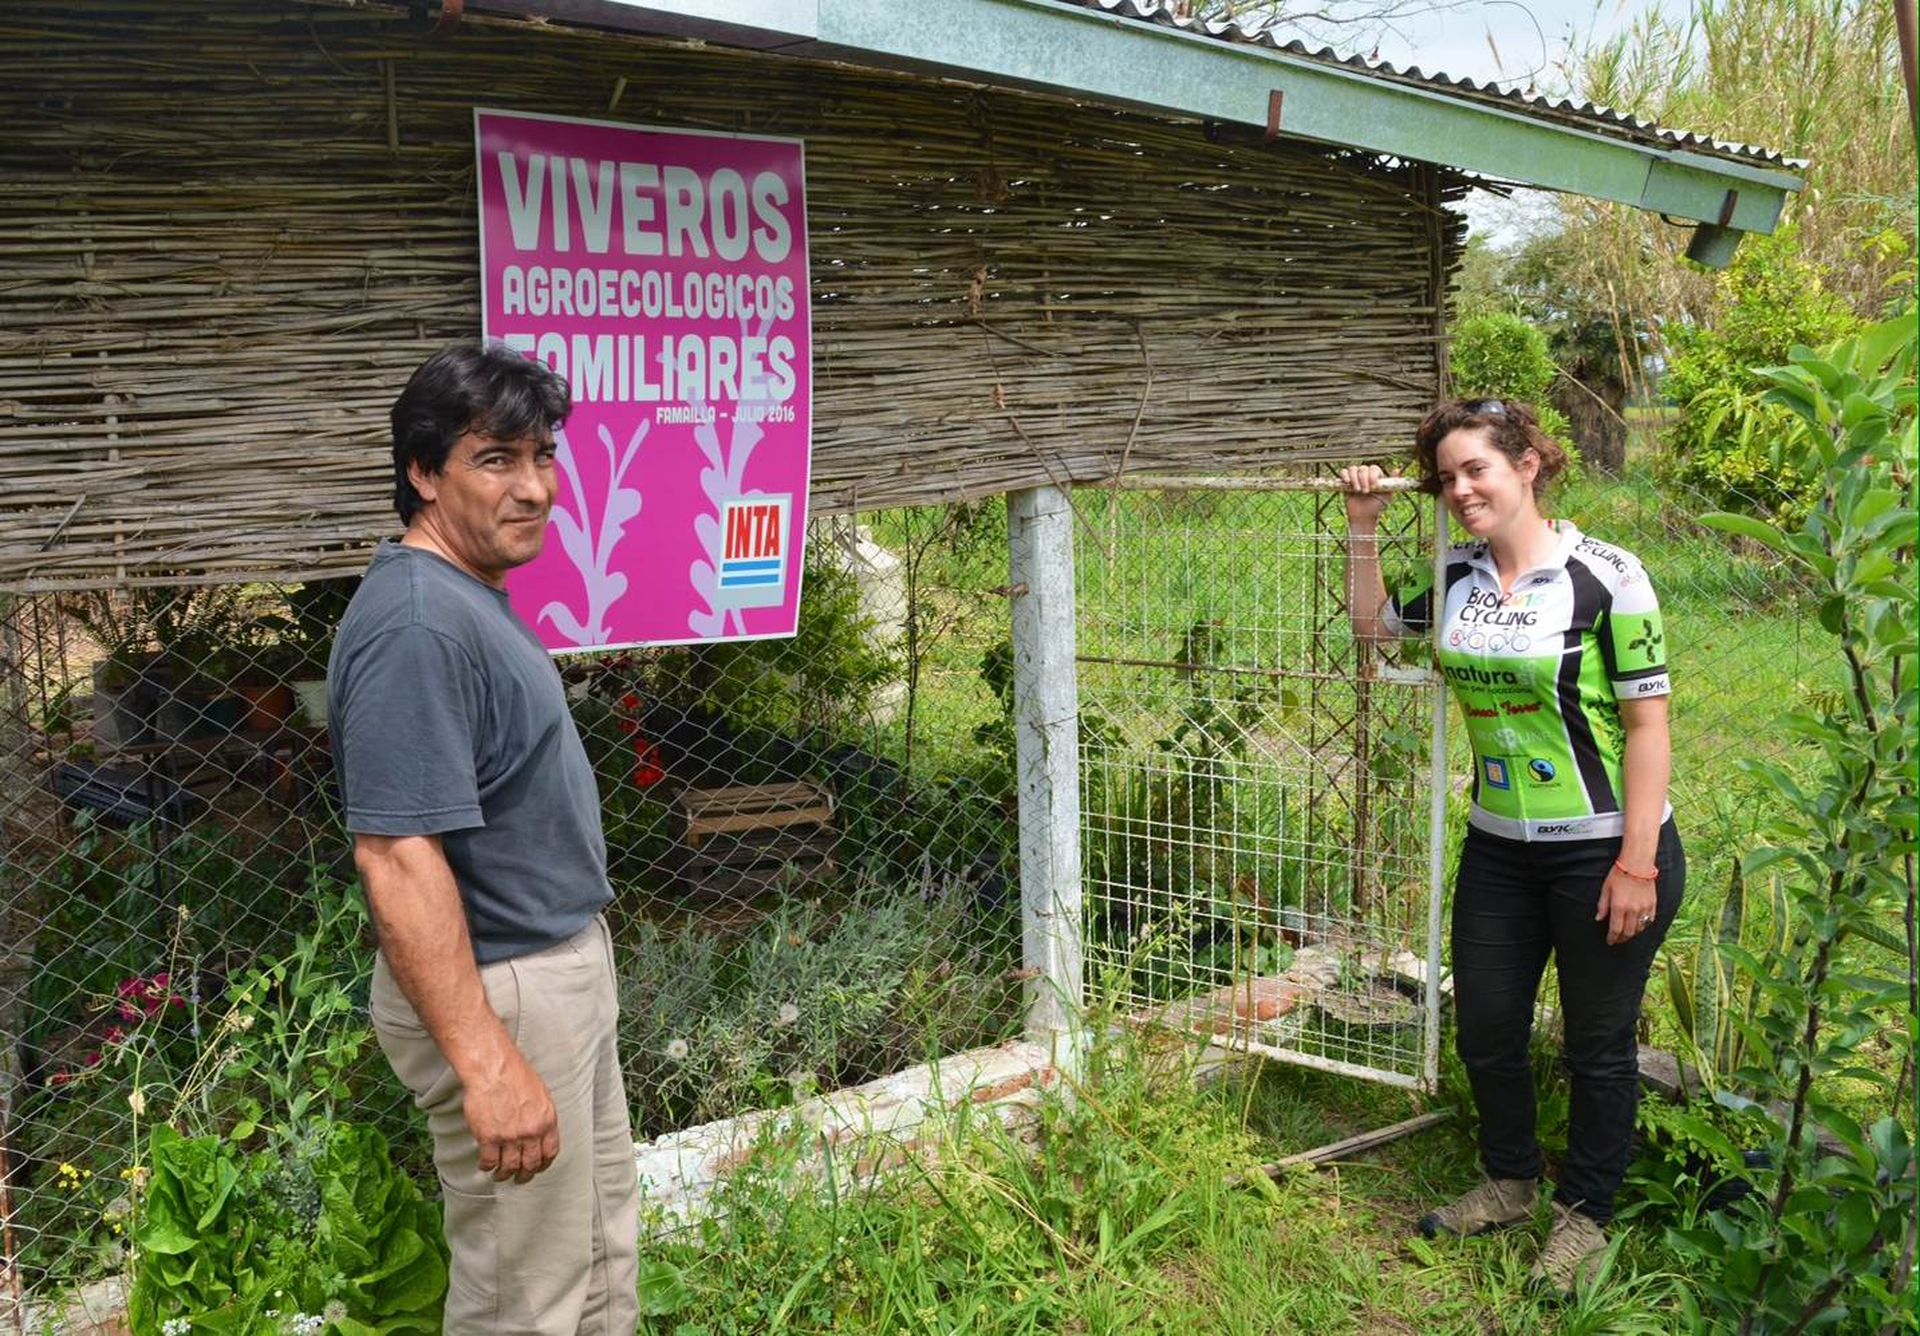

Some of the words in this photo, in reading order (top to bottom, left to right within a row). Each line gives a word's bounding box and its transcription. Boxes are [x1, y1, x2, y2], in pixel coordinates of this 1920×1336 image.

[498, 152, 792, 263] VIVEROS
[503, 265, 795, 321] AGROECOLOGICOS
[656, 406, 716, 424] FAMAILLA
[732, 406, 766, 423] JULIO
[767, 406, 795, 422] 2016
[725, 504, 780, 559] INTA
[1460, 605, 1538, 626] CYCLING
